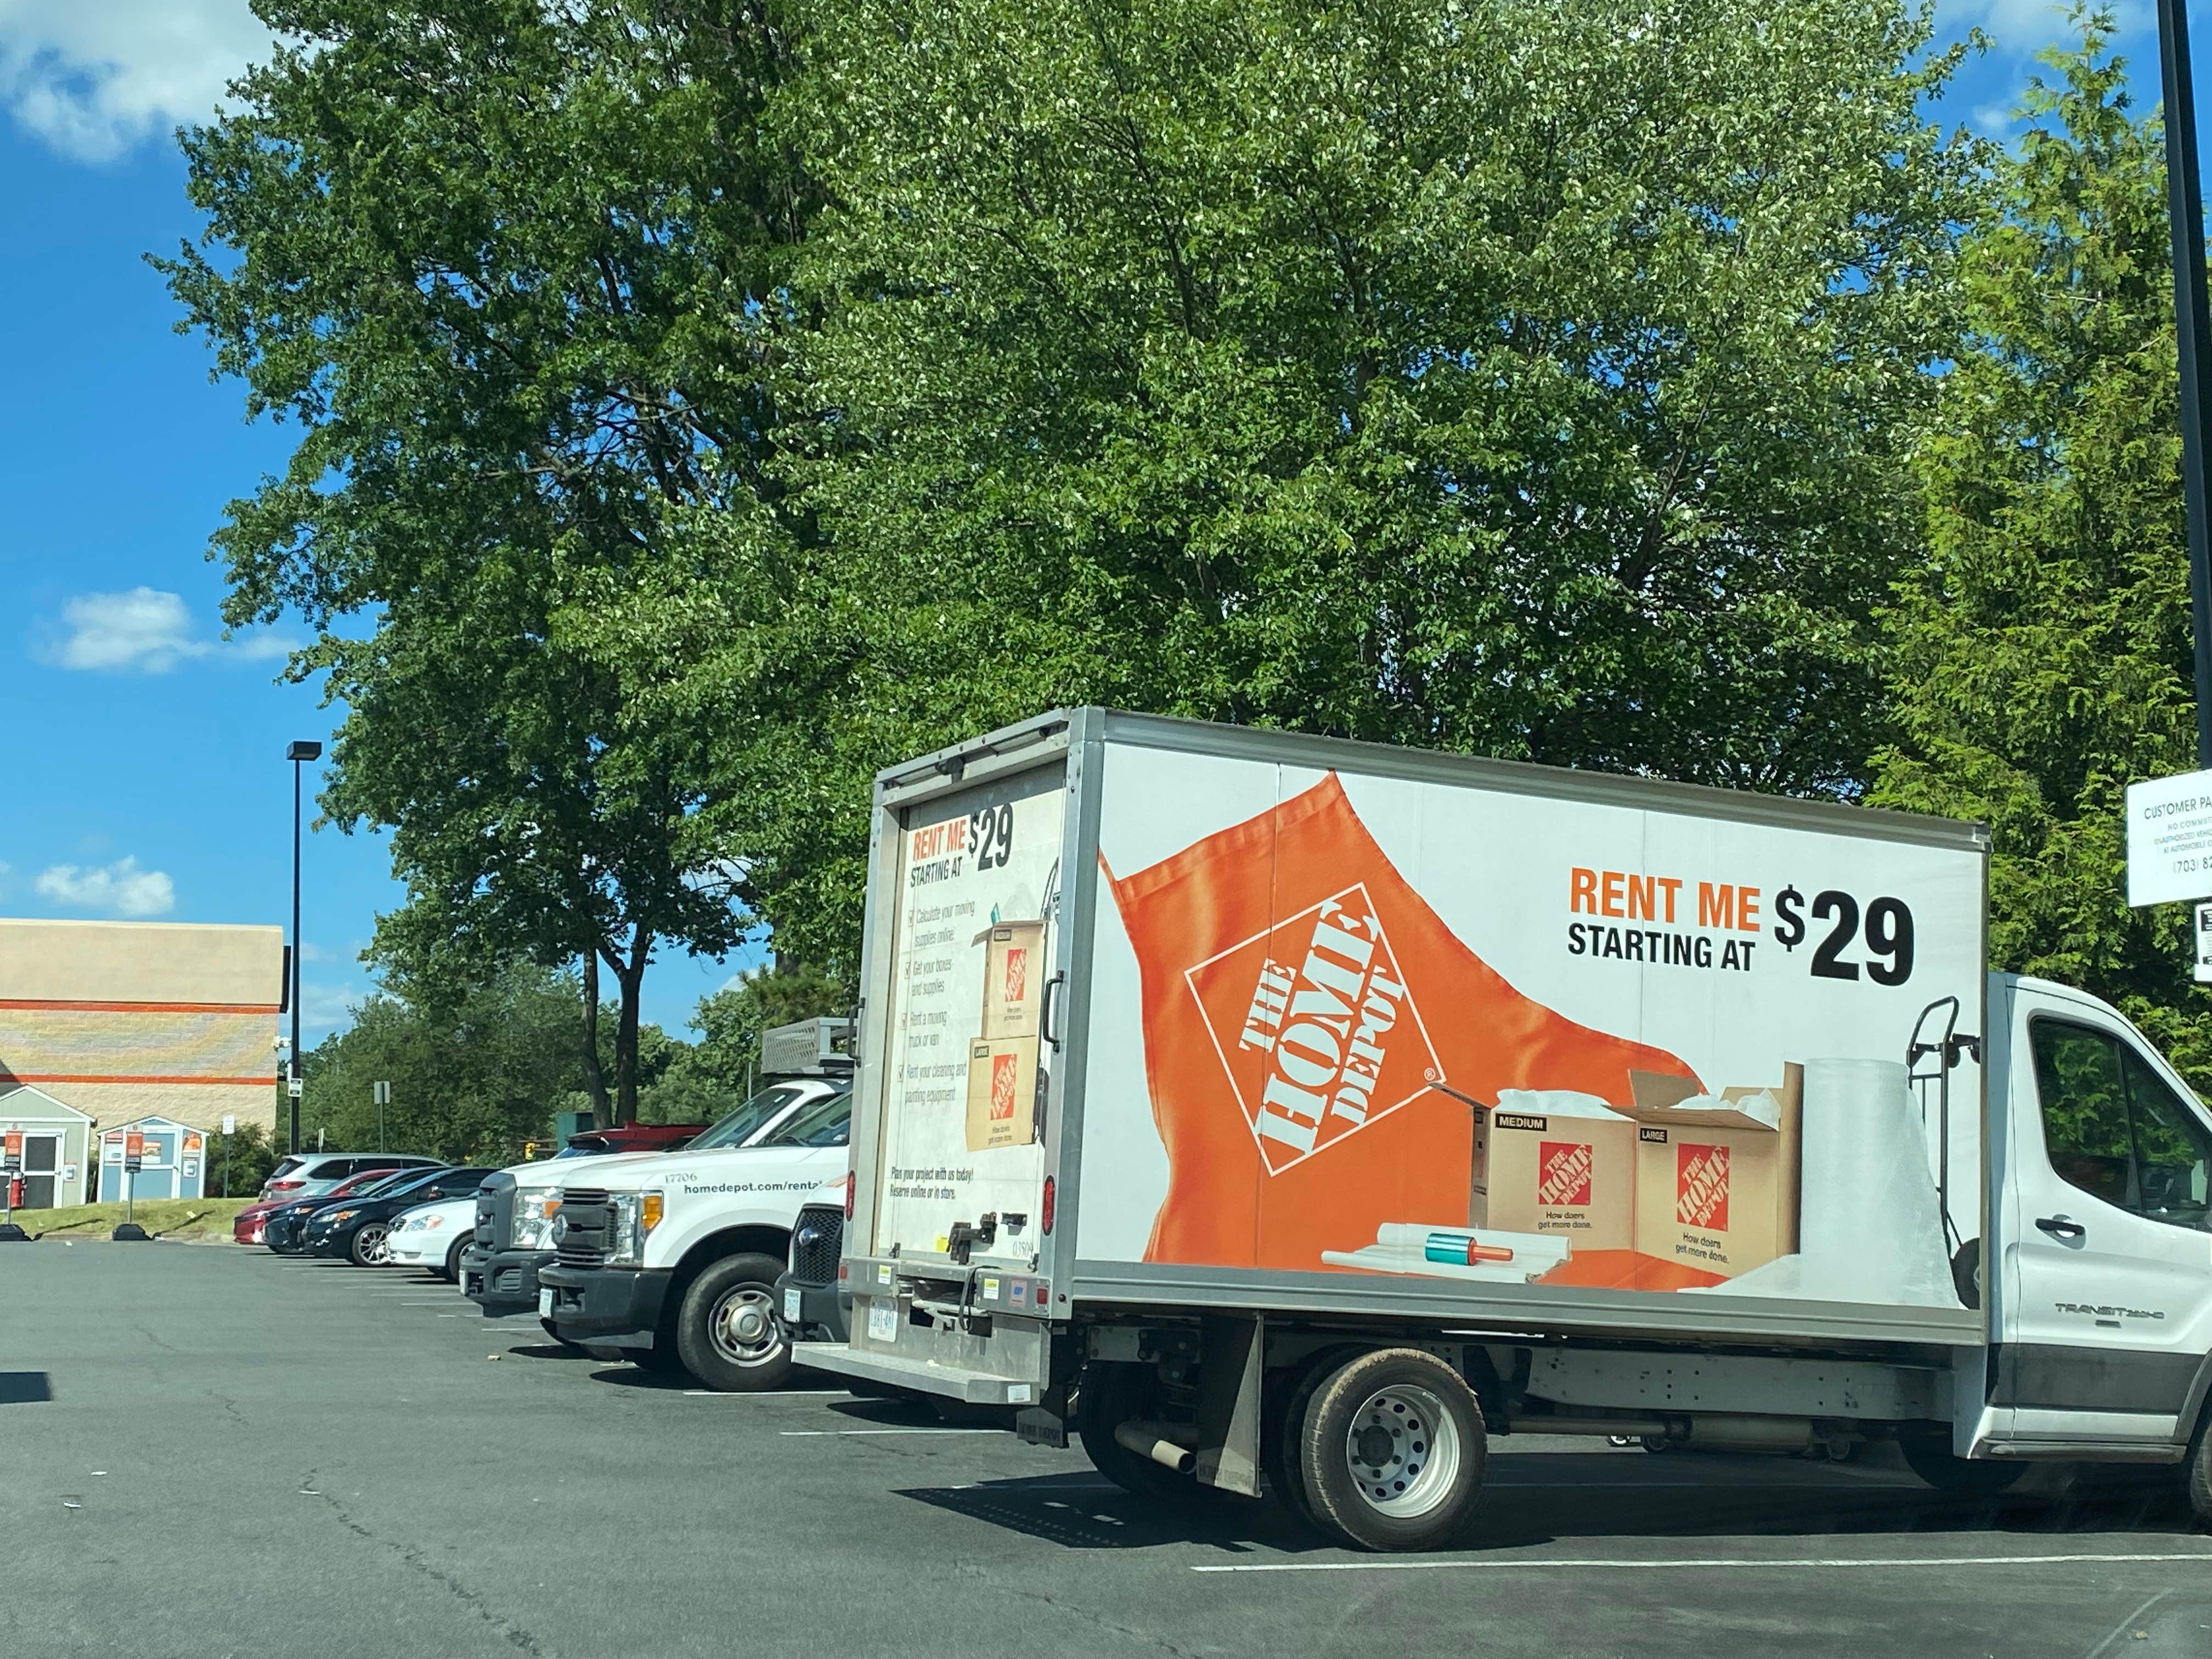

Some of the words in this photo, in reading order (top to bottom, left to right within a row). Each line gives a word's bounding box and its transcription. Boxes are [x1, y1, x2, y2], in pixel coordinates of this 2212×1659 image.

[2144, 798, 2197, 820] CUSTOMER
[913, 825, 944, 861] RENT
[947, 820, 966, 853] ME
[968, 803, 1013, 871] $29
[910, 859, 950, 888] STARTING
[951, 856, 963, 878] AT
[2173, 859, 2199, 874] (703)
[1571, 867, 1683, 924] RENT
[1699, 881, 1760, 932] ME
[1568, 922, 1712, 969] STARTING
[1720, 939, 1756, 972] AT
[1774, 884, 1915, 987] $29
[1239, 958, 1297, 1053] THE
[1254, 899, 1381, 1156] HOME
[1330, 964, 1407, 1126] DEPOT
[1499, 1116, 1543, 1129] MEDIUM
[1641, 1130, 1665, 1141] LARGE
[903, 1170, 915, 1182] your
[1538, 1144, 1593, 1205] HOME
[1545, 1149, 1568, 1174] THE
[1681, 1153, 1705, 1184] THE
[664, 1172, 697, 1184] 17706
[1559, 1166, 1592, 1205] DEPOT
[1677, 1146, 1729, 1225] HOME
[1545, 1211, 1562, 1220] How
[1564, 1211, 1585, 1220] doers
[1696, 1177, 1729, 1227] DEPOT
[1538, 1221, 1550, 1229] get
[1683, 1232, 1700, 1244] How
[1700, 1236, 1722, 1249] doers
[1675, 1243, 1687, 1254] get
[1688, 1246, 1707, 1259] more
